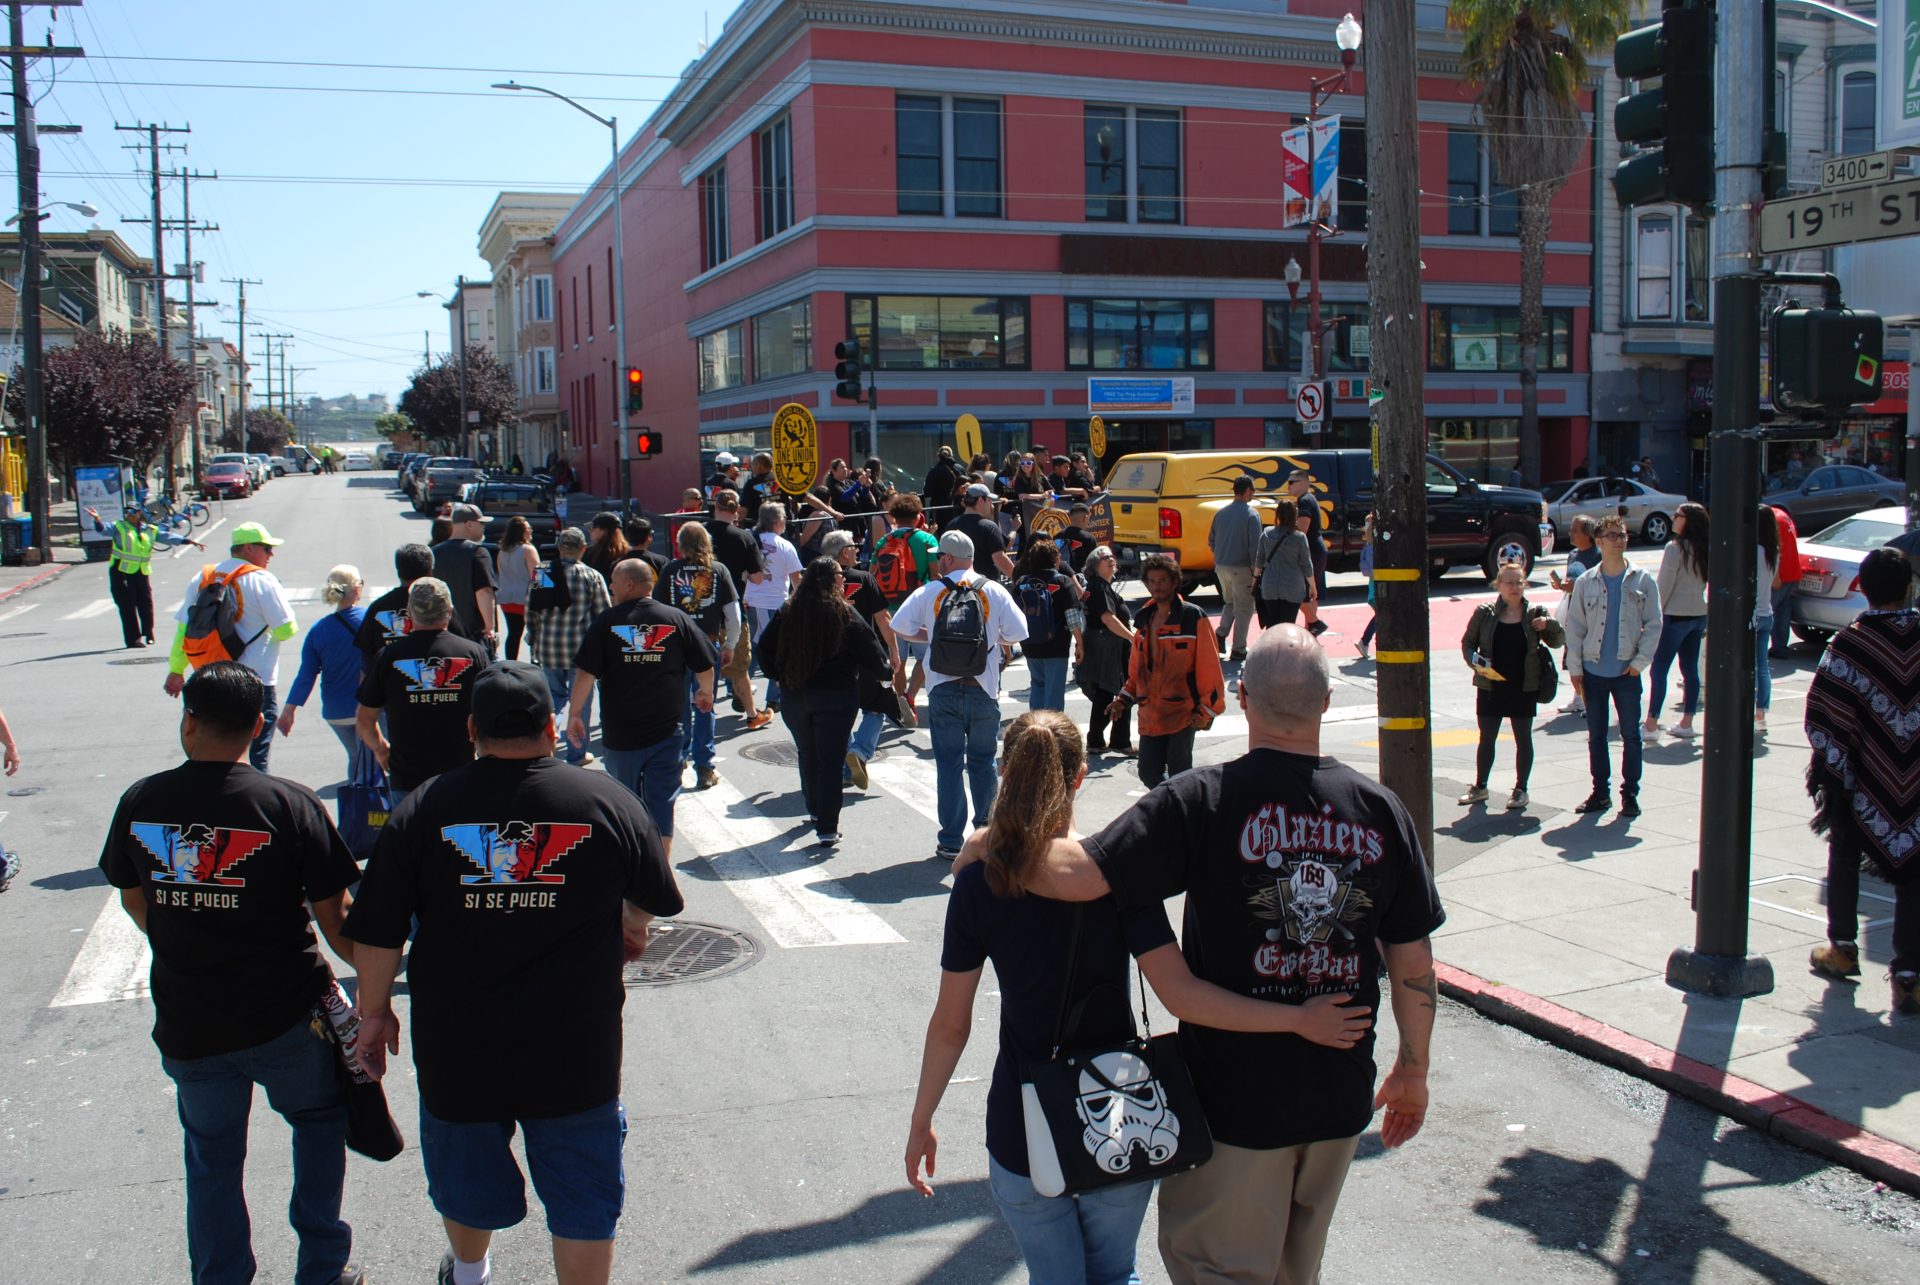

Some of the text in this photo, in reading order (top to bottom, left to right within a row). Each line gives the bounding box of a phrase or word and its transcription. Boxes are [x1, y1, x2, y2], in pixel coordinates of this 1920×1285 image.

[1826, 158, 1868, 184] 3400
[1786, 201, 1854, 240] 19TH
[782, 407, 793, 417] AND
[776, 448, 814, 463] ONE UNION
[624, 655, 632, 663] SI
[642, 654, 662, 662] PUEDE
[409, 692, 459, 703] SI SE PUEDE
[1240, 802, 1384, 863] Glaziers
[1300, 862, 1326, 889] 169
[156, 889, 240, 908] SI SE PUEDE
[464, 891, 558, 909] SI SE PUEDE
